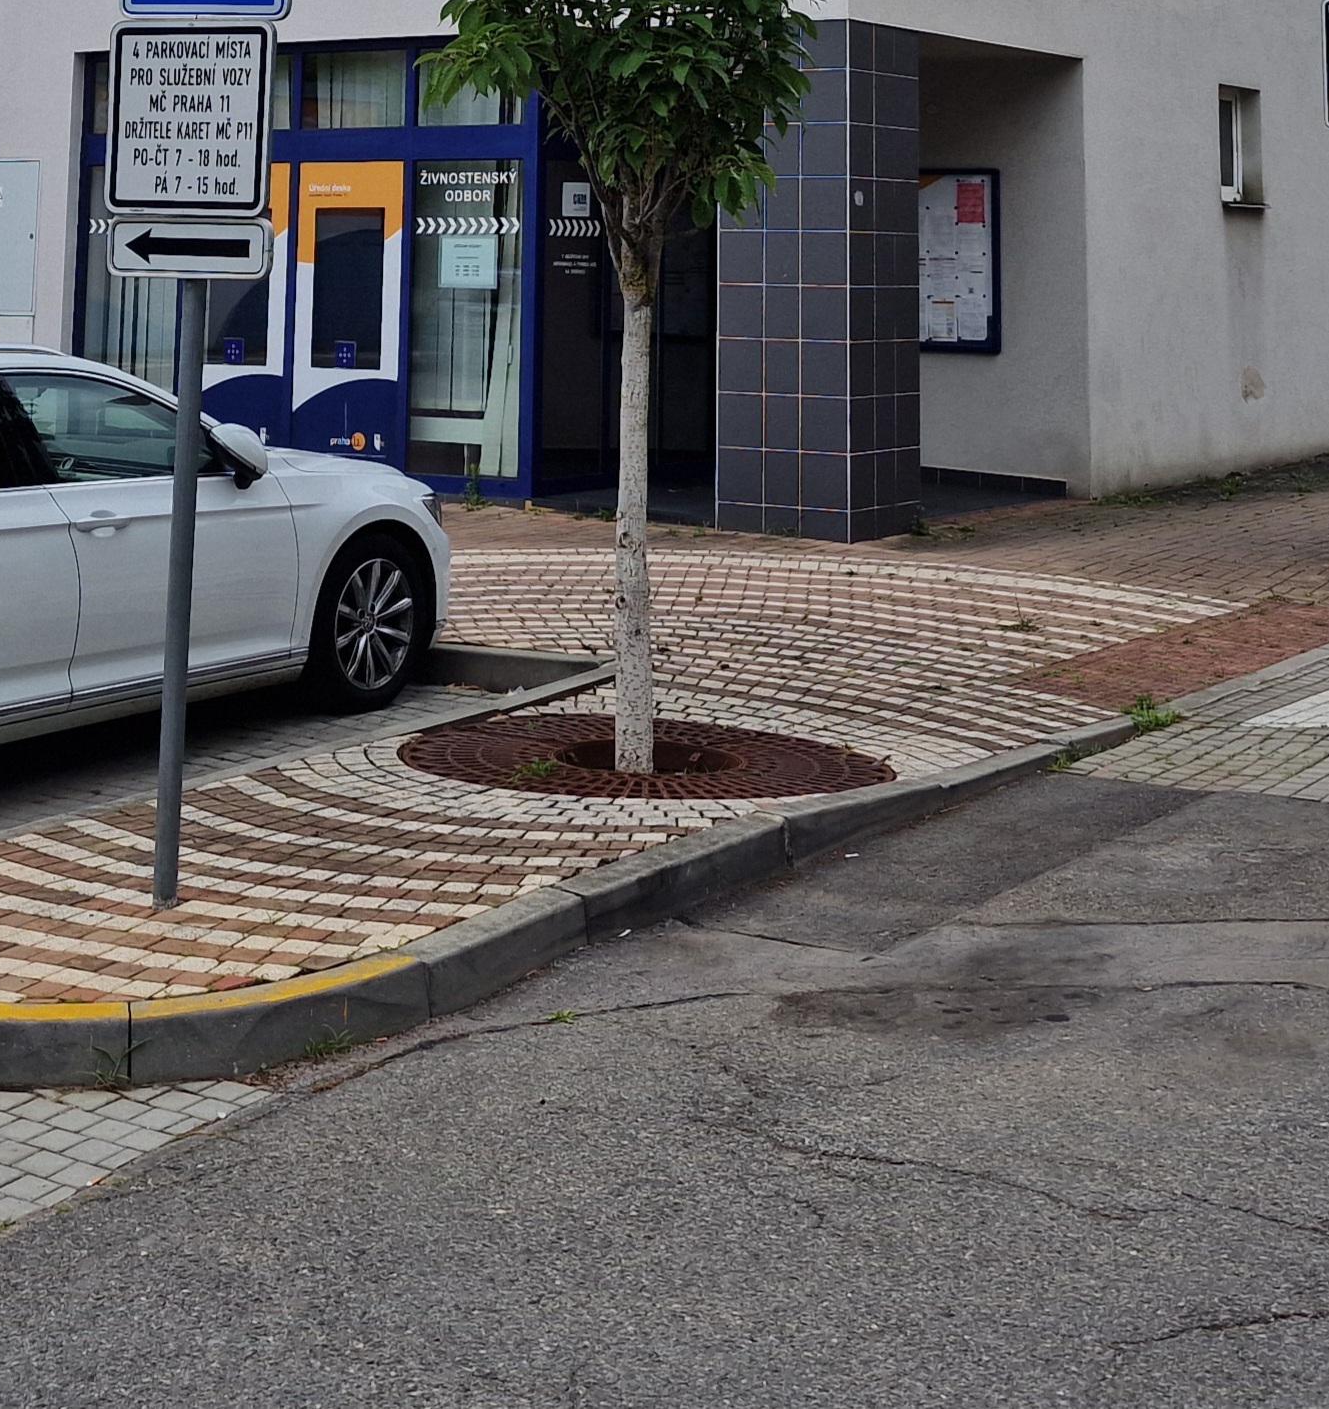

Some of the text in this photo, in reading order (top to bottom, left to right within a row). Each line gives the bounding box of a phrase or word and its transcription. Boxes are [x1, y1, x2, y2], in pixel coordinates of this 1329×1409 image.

[133, 36, 251, 59] 4 PARKOVACÍ MÍSTA
[130, 62, 252, 86] PRO SLUŽEBNÍ VOZY
[149, 90, 230, 113] MČ PRAHA 11
[124, 117, 253, 140] DRŽITELE KARET MČ P11
[133, 144, 170, 166] PO-ČT
[175, 149, 182, 166] 7
[198, 149, 210, 167] 18
[215, 149, 241, 168] hod.
[154, 170, 168, 194] PÁ
[175, 176, 182, 194] 7
[196, 176, 209, 195] 15
[214, 176, 239, 196] hod.
[420, 169, 517, 185] ŽIVNOSTENSKÝ
[445, 189, 491, 202] ODBOR
